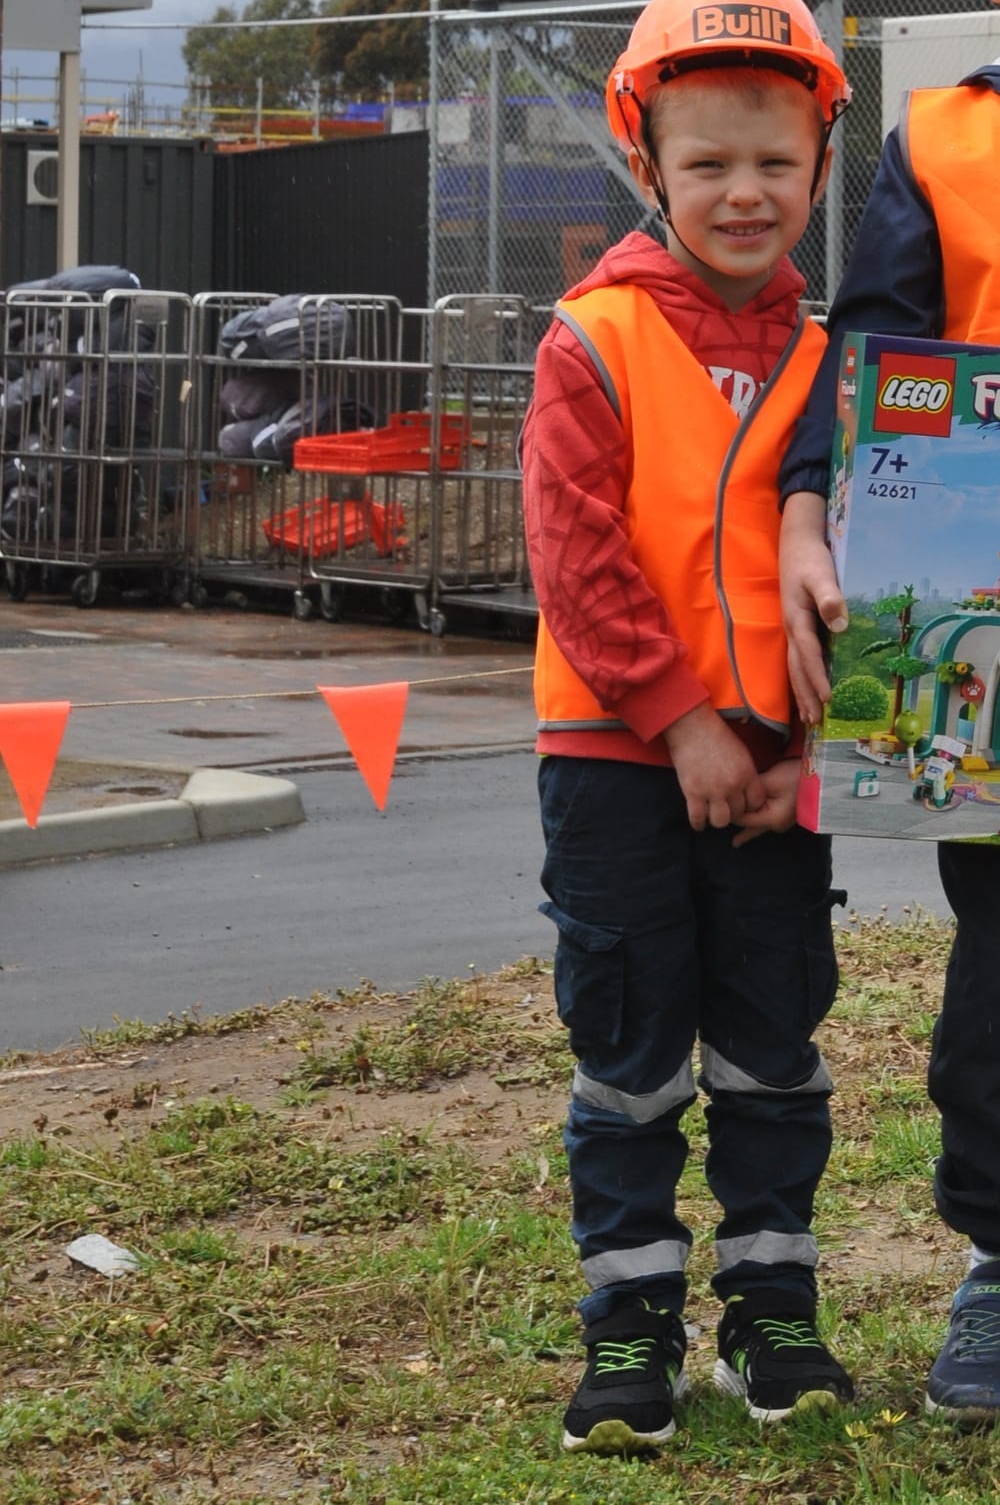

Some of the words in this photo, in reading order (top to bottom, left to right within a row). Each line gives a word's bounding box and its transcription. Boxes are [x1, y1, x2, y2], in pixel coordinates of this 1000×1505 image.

[697, 7, 788, 42] Built
[881, 377, 951, 412] LEGO
[871, 448, 909, 475] 7+
[867, 483, 917, 500] 42621
